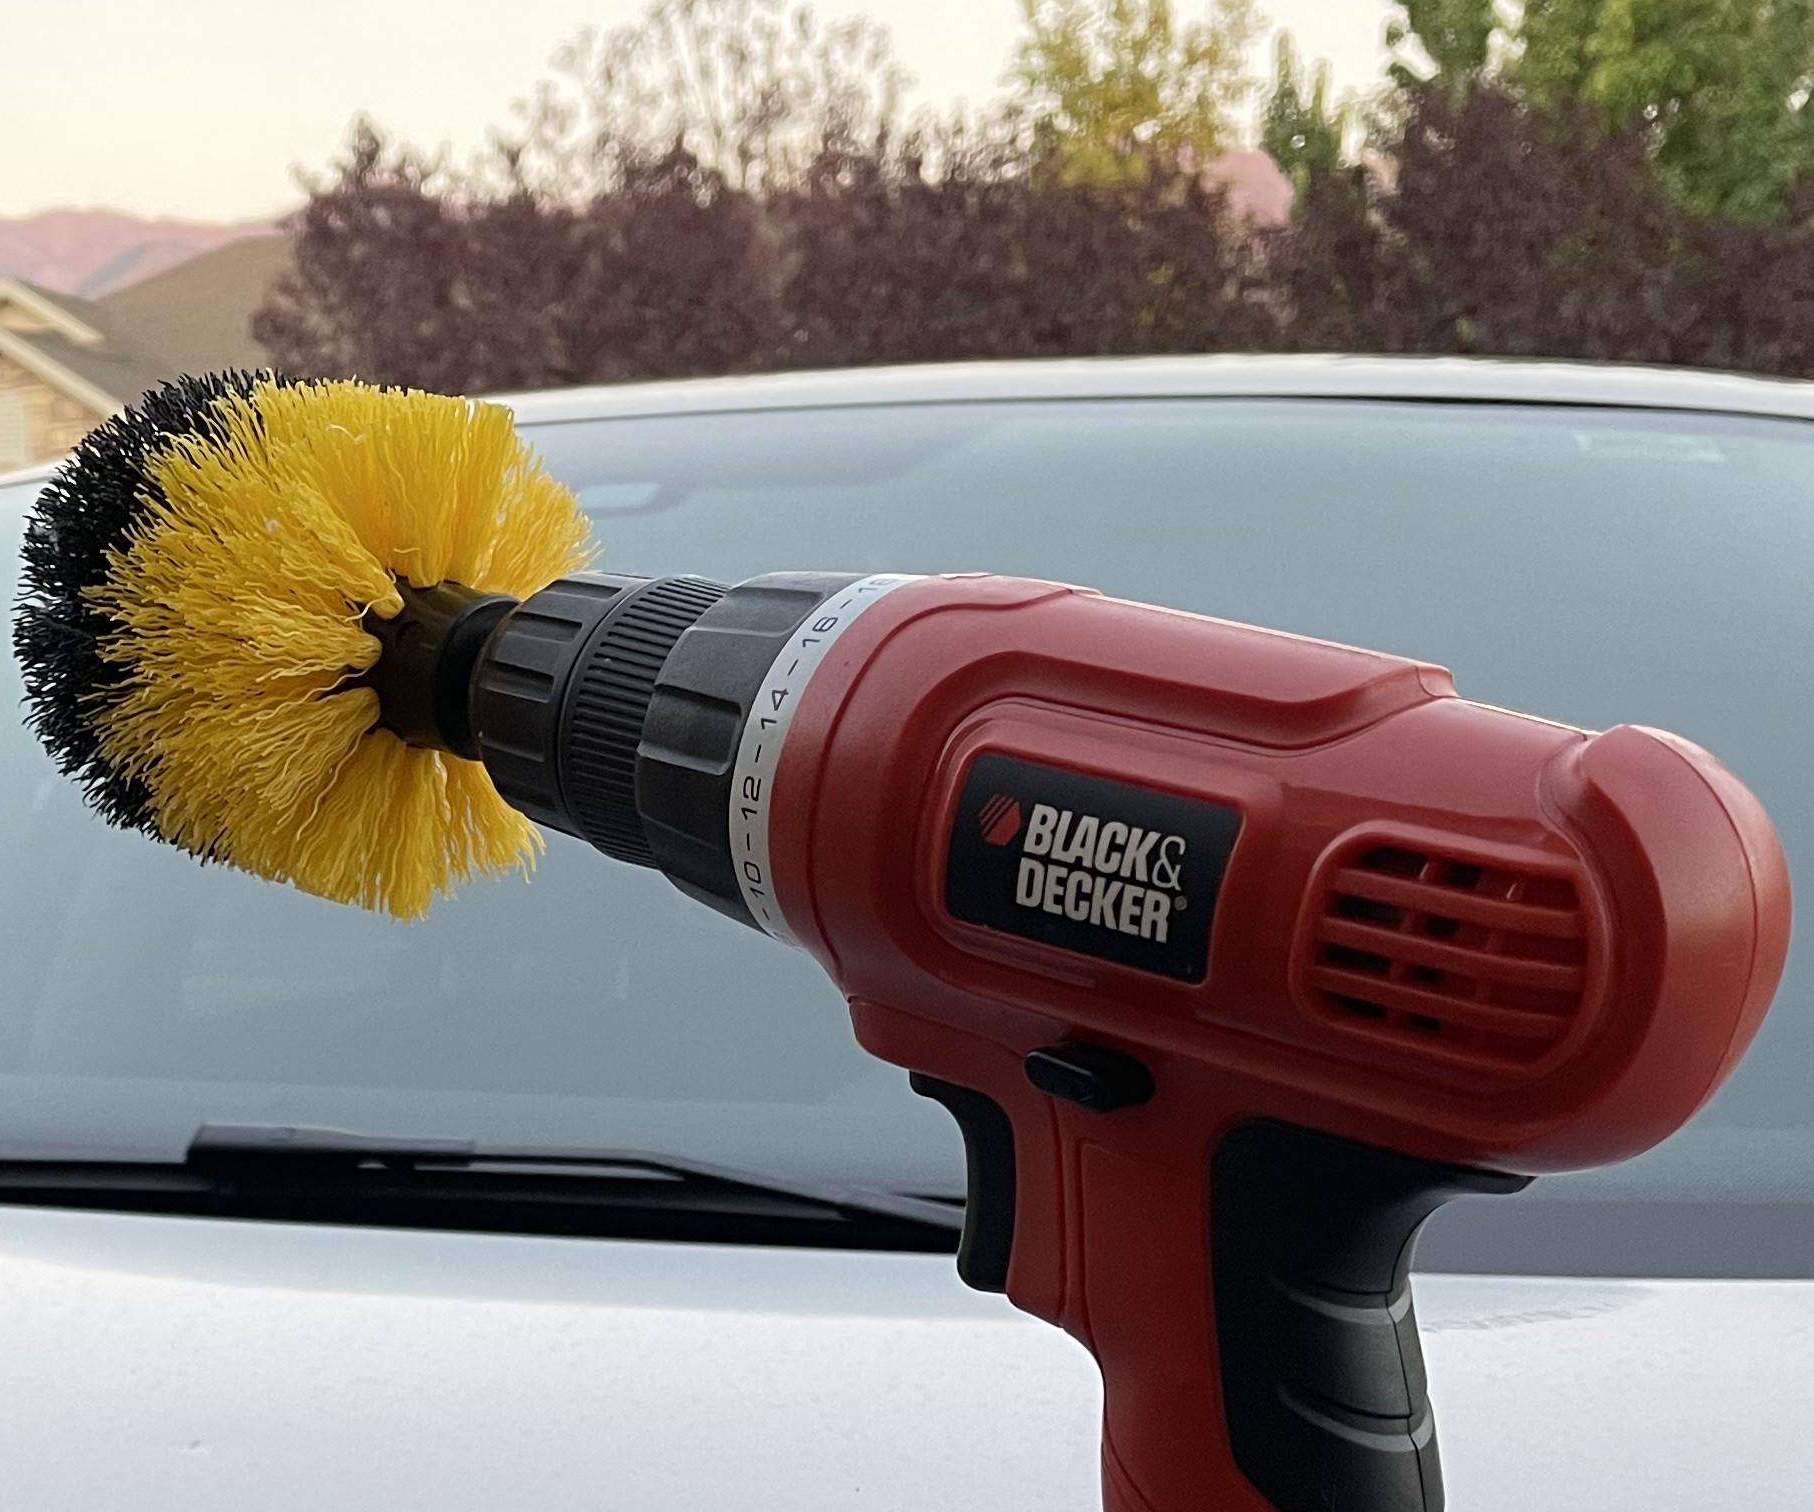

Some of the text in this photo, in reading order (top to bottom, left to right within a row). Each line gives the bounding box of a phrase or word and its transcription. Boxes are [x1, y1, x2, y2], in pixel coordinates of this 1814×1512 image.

[740, 775, 763, 821] 12
[760, 688, 790, 730] 14
[802, 615, 839, 648] 16
[1015, 857, 1172, 944] DECKER
